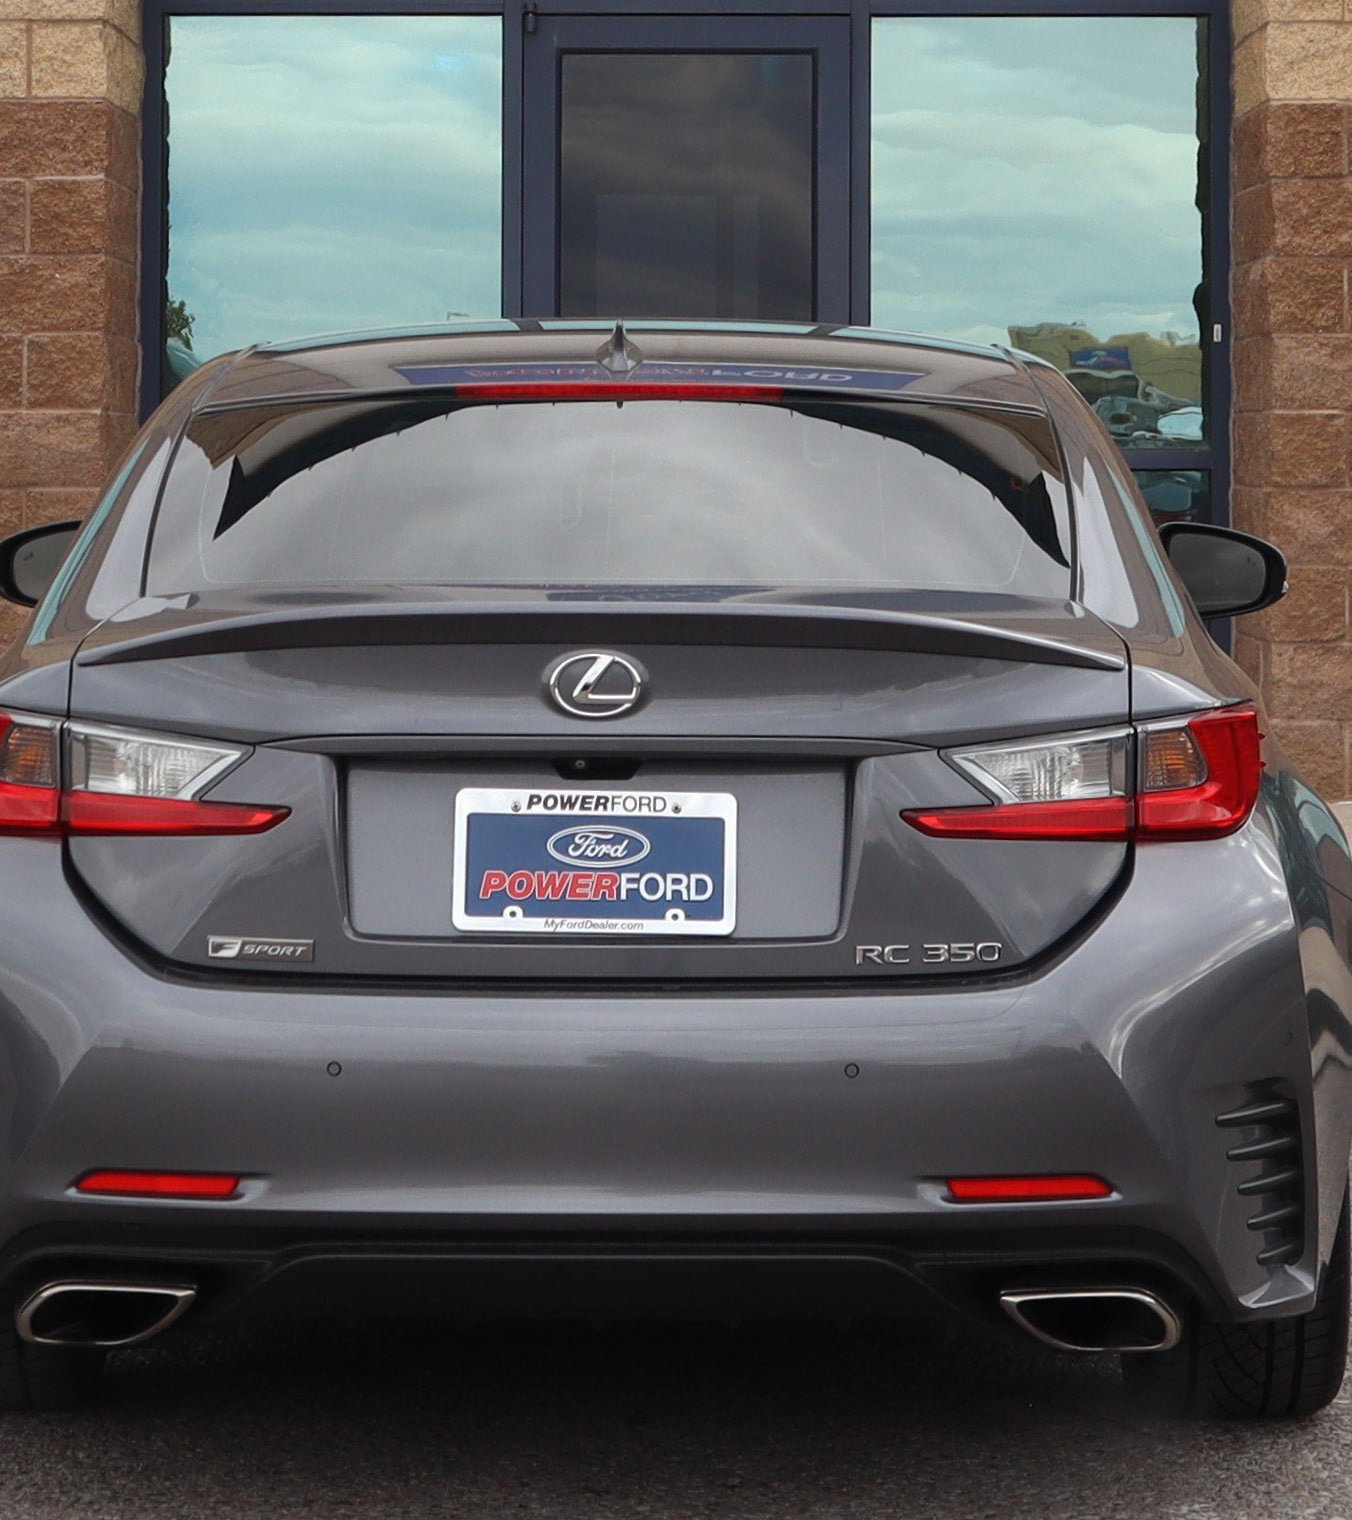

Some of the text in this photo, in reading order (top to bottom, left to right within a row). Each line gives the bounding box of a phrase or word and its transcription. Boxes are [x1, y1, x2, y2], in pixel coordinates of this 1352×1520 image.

[526, 793, 667, 813] POWERFORD
[567, 832, 629, 859] Ford
[479, 869, 715, 902] POWERFORD
[543, 917, 645, 932] MyFordDealer.com
[242, 943, 308, 957] SPORT
[855, 942, 1003, 965] RC 350
